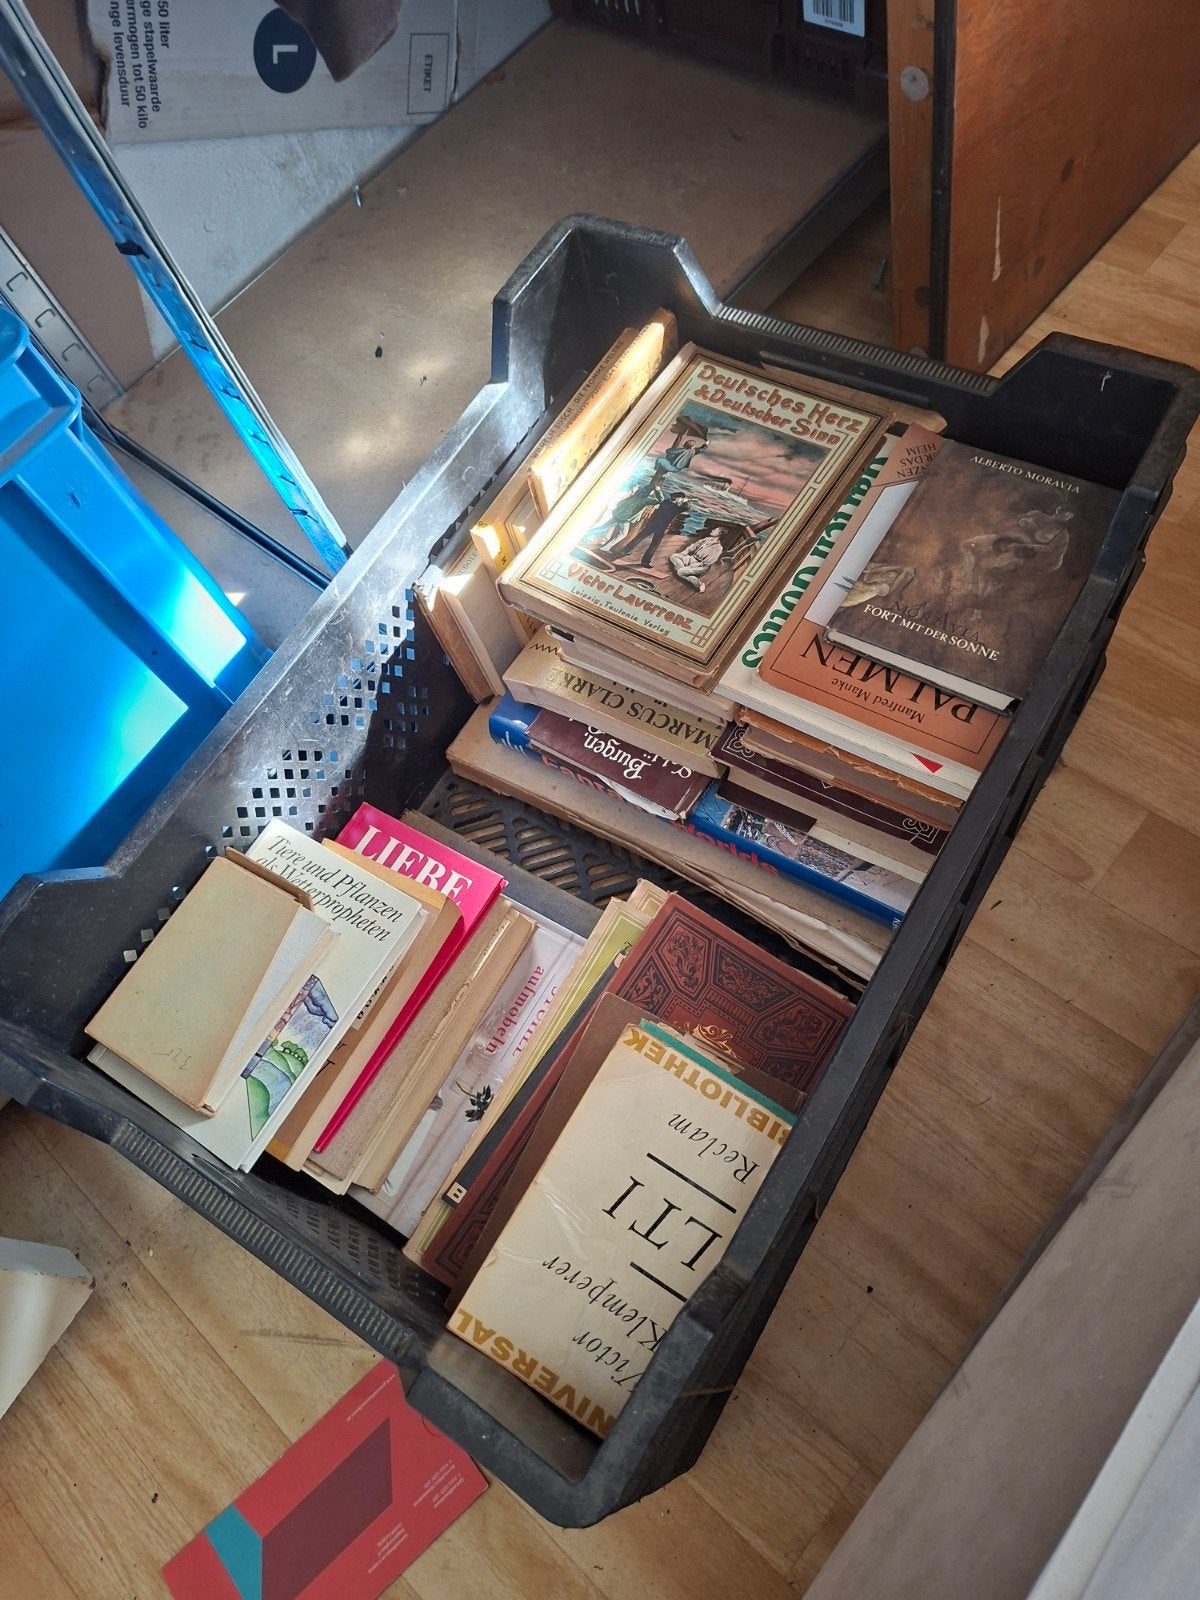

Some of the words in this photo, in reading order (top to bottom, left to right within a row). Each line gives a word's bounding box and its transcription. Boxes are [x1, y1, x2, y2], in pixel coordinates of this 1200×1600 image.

[108, 0, 121, 28] nge
[158, 1, 169, 18] 50
[159, 21, 171, 49] liter
[272, 44, 299, 65] L
[113, 31, 130, 107] levensduur
[132, 63, 143, 82] tot
[143, 21, 162, 113] stapelwaarde
[422, 53, 434, 93] ETIKET
[135, 85, 147, 101] 50
[136, 105, 149, 129] kilo
[555, 407, 575, 429] BUSCH
[573, 391, 584, 405] DIE
[582, 363, 607, 393] FROMME
[697, 364, 806, 414] Deutsches
[808, 402, 864, 433] Herz
[900, 455, 923, 466] DAS
[906, 443, 937, 456] HEIM
[969, 454, 1025, 476] ALBERTO
[1025, 470, 1081, 495] MORAVIA
[567, 561, 616, 595] Victor
[643, 618, 671, 636] Verlag
[863, 604, 902, 624] FORT
[900, 618, 926, 632] MIT
[924, 627, 948, 643] DER
[949, 635, 1000, 661] SONNE
[545, 665, 628, 711] CLARKE
[800, 632, 978, 726] PALMEN
[831, 677, 869, 697] Manke
[616, 700, 717, 750] MARCUS
[872, 693, 926, 725] Manfred
[583, 732, 652, 780] Burgen,
[267, 835, 307, 866] Tiere
[302, 860, 341, 883] und
[331, 874, 404, 923] Pflanzen
[353, 824, 473, 909] LIEBE
[278, 863, 392, 942] Wetterpropheten
[486, 966, 545, 1053] aufmöbeln
[622, 1028, 792, 1146] BIBLIOTHEK
[668, 1112, 761, 1185] Reclam
[602, 1175, 723, 1272] LTI
[542, 1255, 666, 1353] Klemperer
[457, 1307, 616, 1436] NIVERSAL
